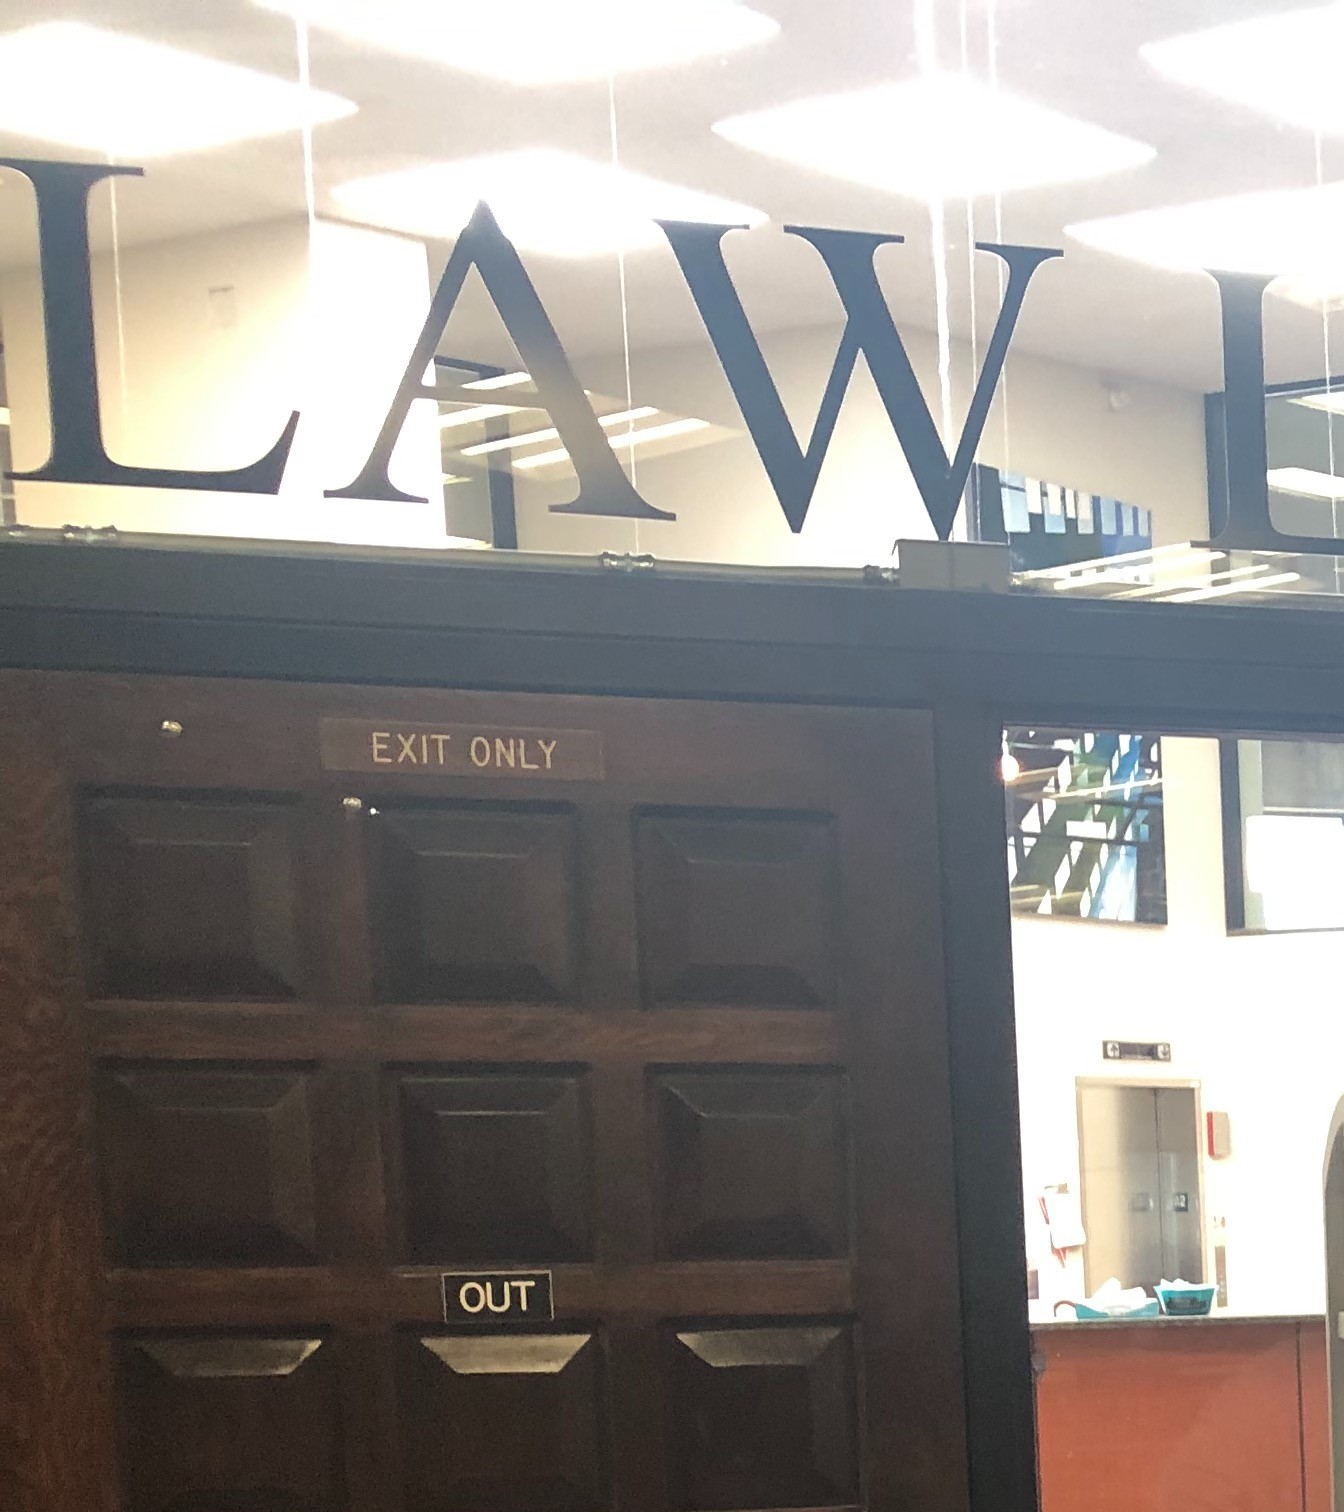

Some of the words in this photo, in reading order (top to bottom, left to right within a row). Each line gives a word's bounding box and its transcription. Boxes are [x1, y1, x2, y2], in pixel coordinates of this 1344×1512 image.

[0, 156, 1064, 543] LAW
[372, 732, 450, 764] EXIT
[470, 736, 556, 769] ONLY
[459, 1281, 536, 1313] OUT
